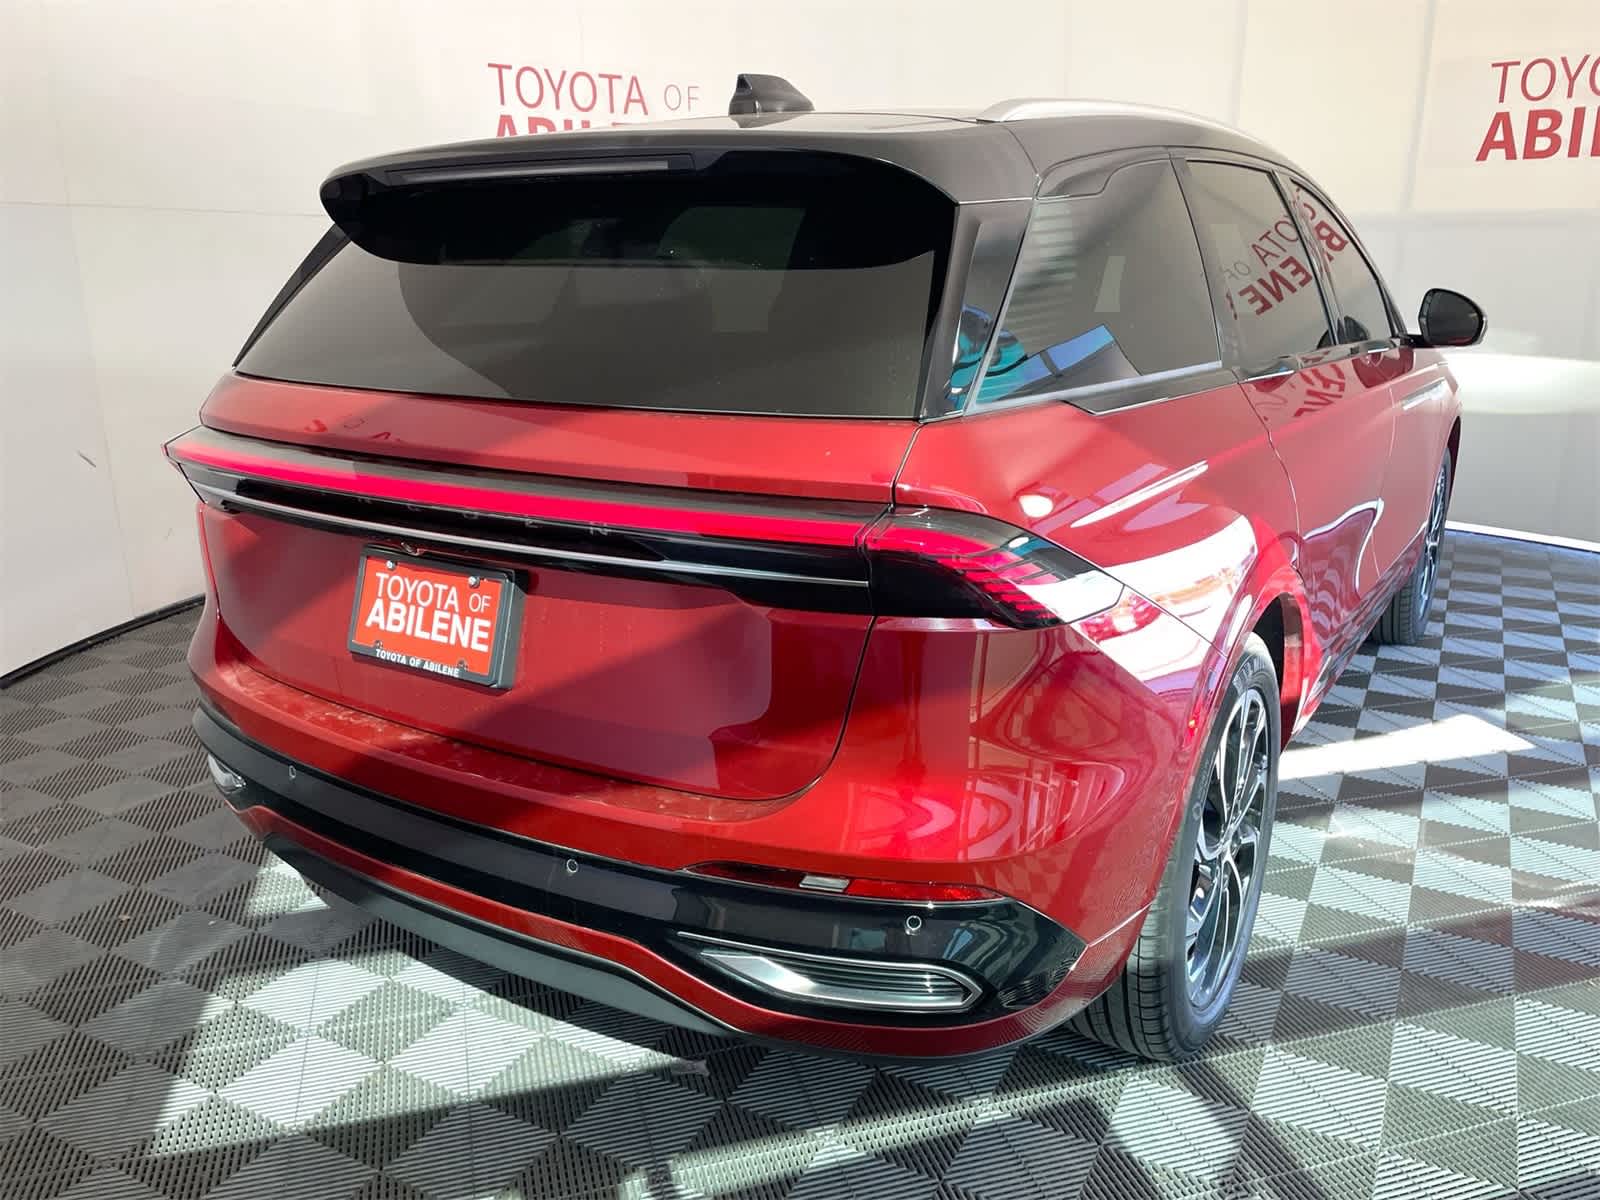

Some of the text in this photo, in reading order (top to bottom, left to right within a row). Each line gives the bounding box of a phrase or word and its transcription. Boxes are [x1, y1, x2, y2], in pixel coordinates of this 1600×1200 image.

[487, 62, 700, 115] TOYOTA OF
[375, 572, 492, 613] TOYOTA OF
[365, 598, 491, 653] ABILENE
[375, 648, 460, 677] TOYOTA OF ABILENE
